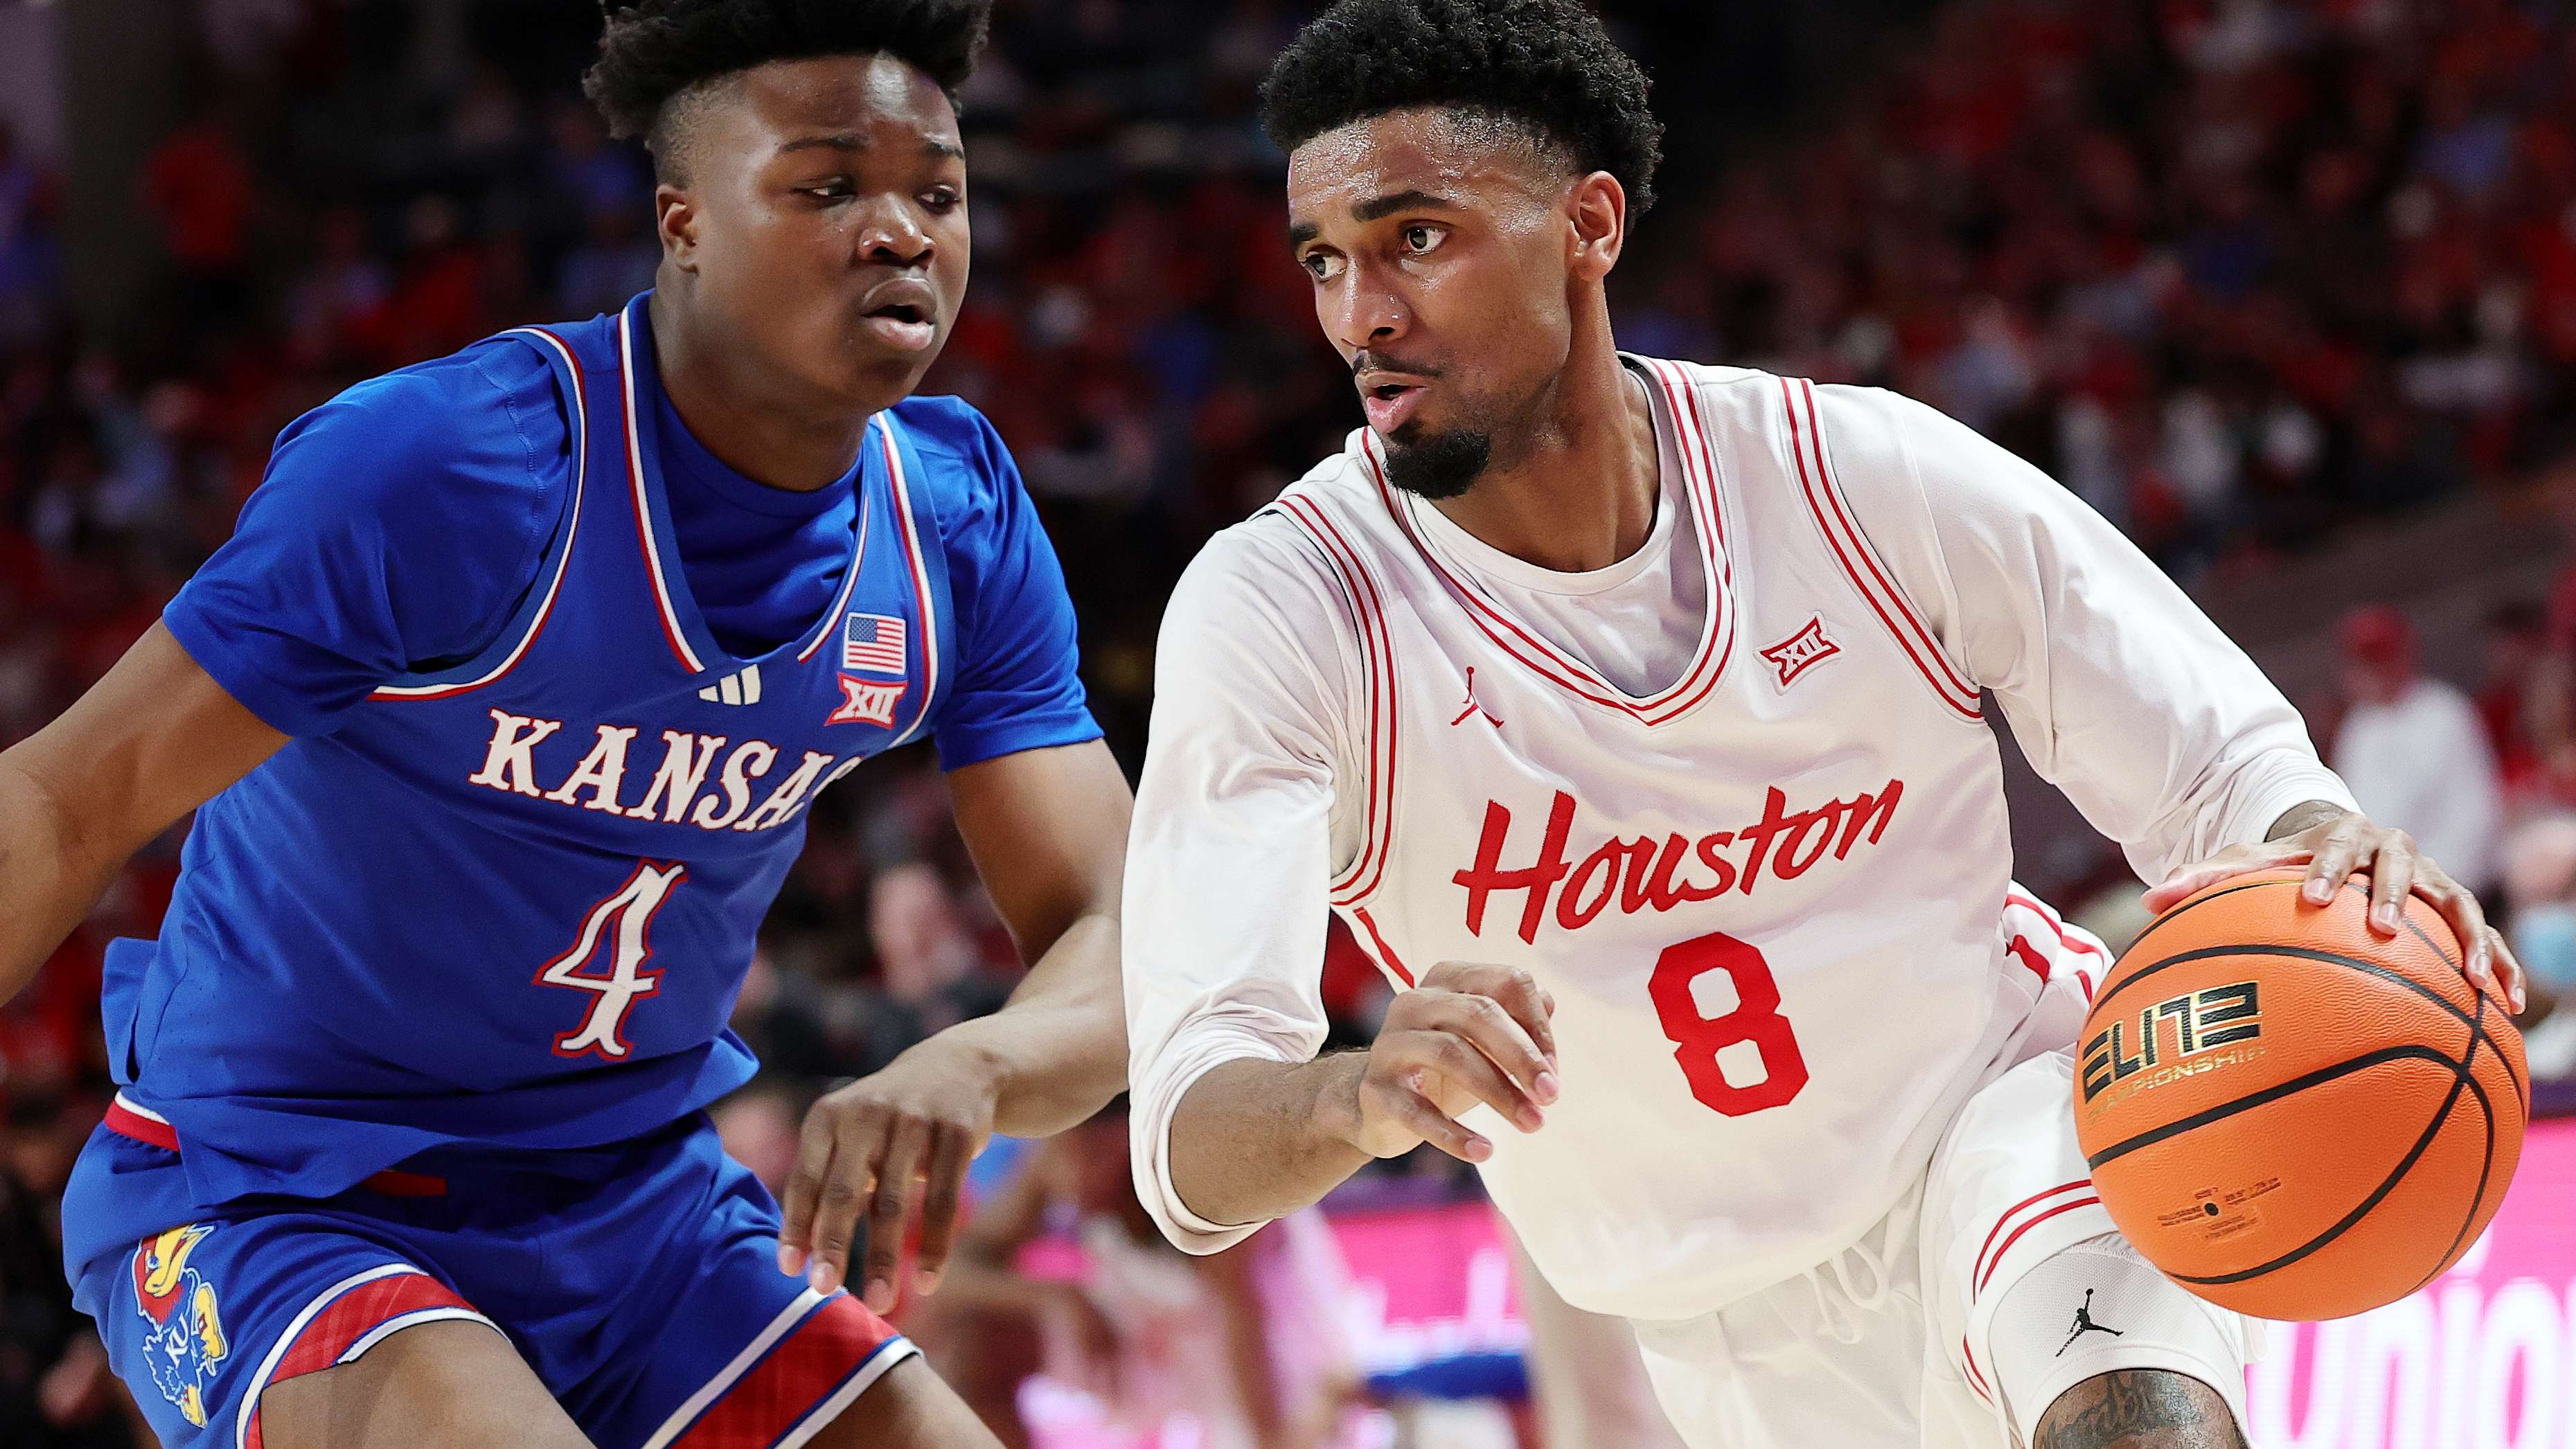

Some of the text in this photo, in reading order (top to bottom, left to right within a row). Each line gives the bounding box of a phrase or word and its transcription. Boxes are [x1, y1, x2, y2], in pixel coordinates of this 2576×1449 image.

[830, 675, 907, 727] XII
[1764, 620, 1837, 683] XII
[1452, 779, 1903, 945] Houston
[533, 857, 688, 1063] 4
[1648, 932, 1809, 1117] 8
[2083, 980, 2262, 1103] ELITE
